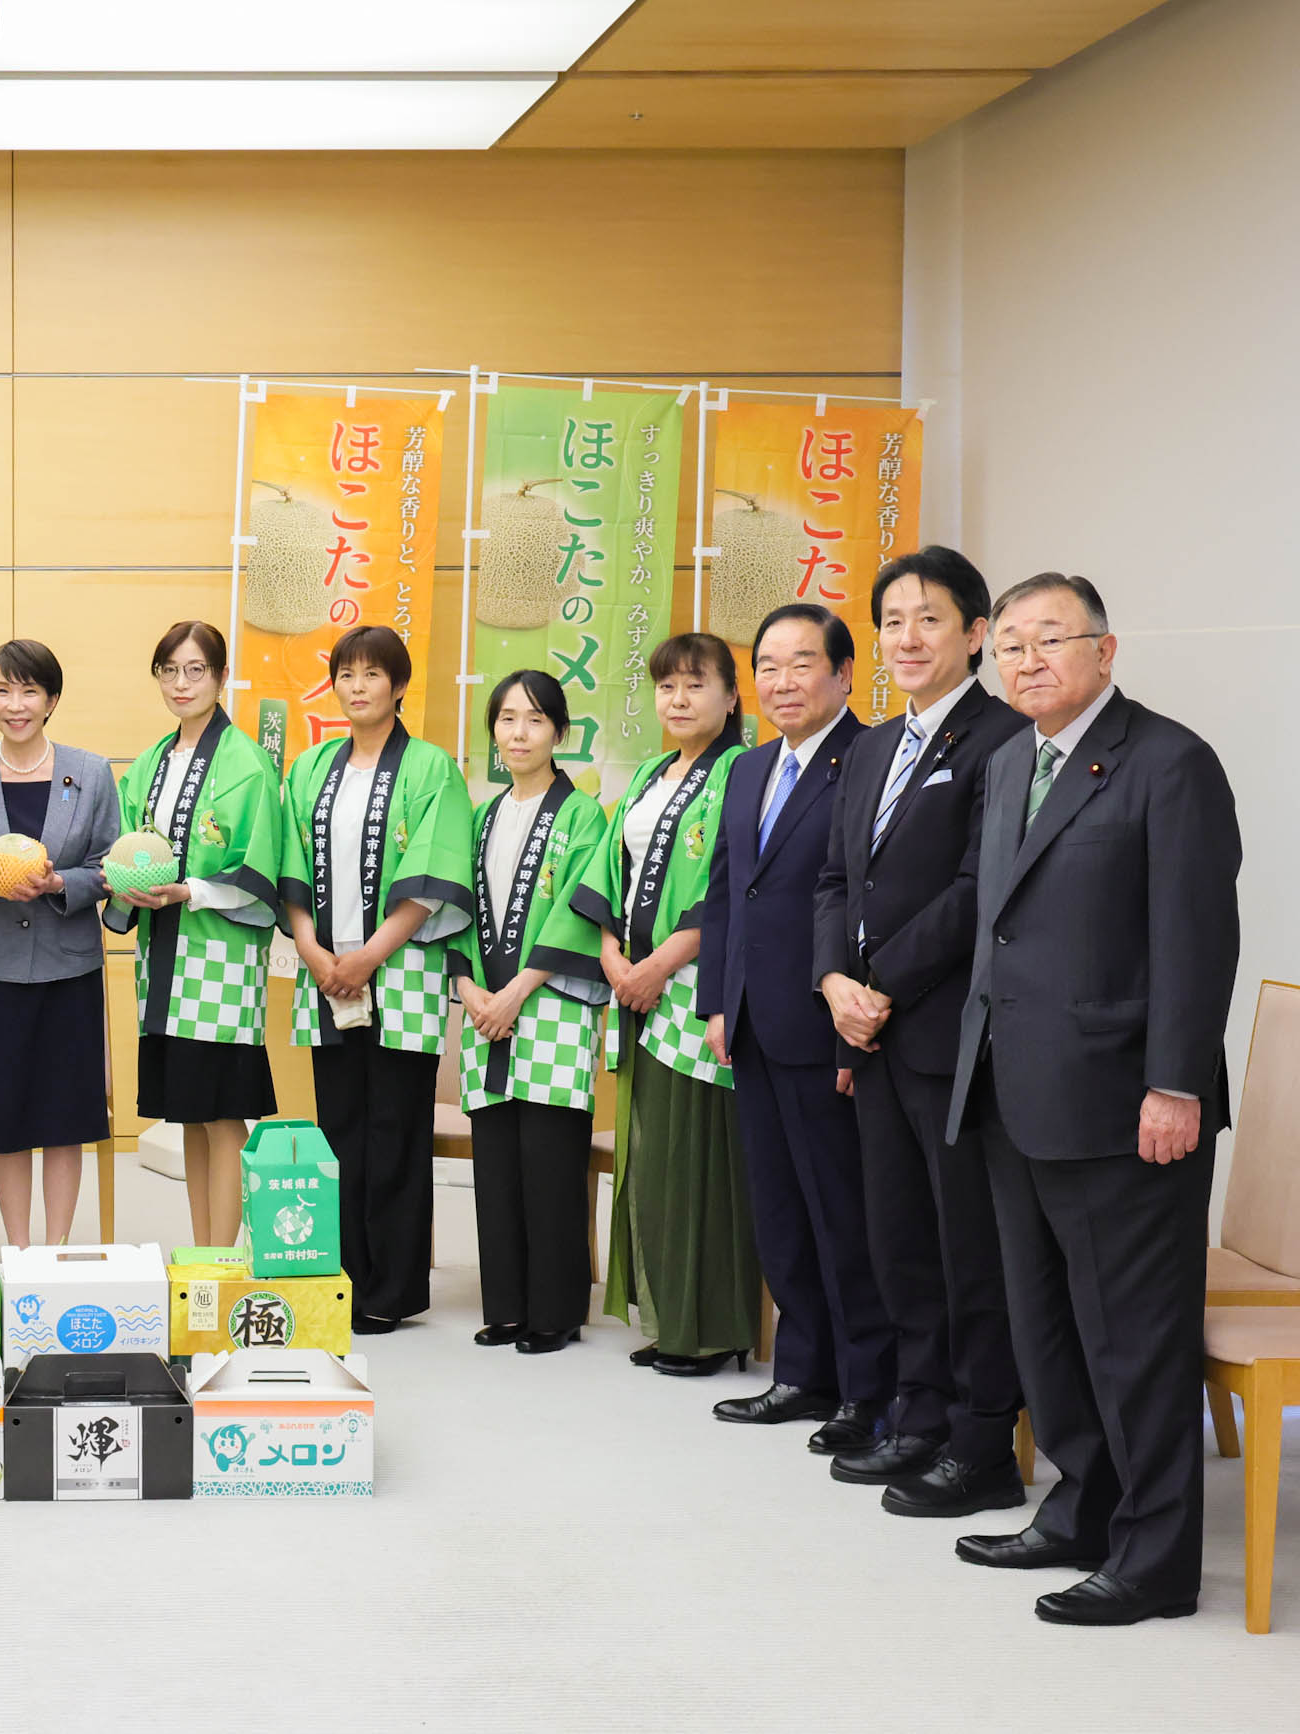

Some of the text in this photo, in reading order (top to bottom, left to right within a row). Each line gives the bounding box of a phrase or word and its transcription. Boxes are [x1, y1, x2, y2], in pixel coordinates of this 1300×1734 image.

[621, 424, 661, 738] すっきり爽やか、みずみずしい
[315, 769, 340, 909] 茨城県鉾田市産メロン
[363, 771, 392, 910] 茨城県鉾田市産メロン
[641, 768, 707, 907] 茨城県鉾田市産メロン
[504, 812, 555, 955] 茨城県鉾田市産メロン
[268, 1178, 320, 1191] 茨城県産
[285, 1249, 329, 1261] 市村知一
[70, 1317, 103, 1331] ほこた
[70, 1338, 103, 1349] メロン
[119, 1337, 162, 1346] イバラキング
[232, 1298, 287, 1348] 極
[67, 1416, 124, 1472] 輝
[258, 1444, 346, 1466] メロン
